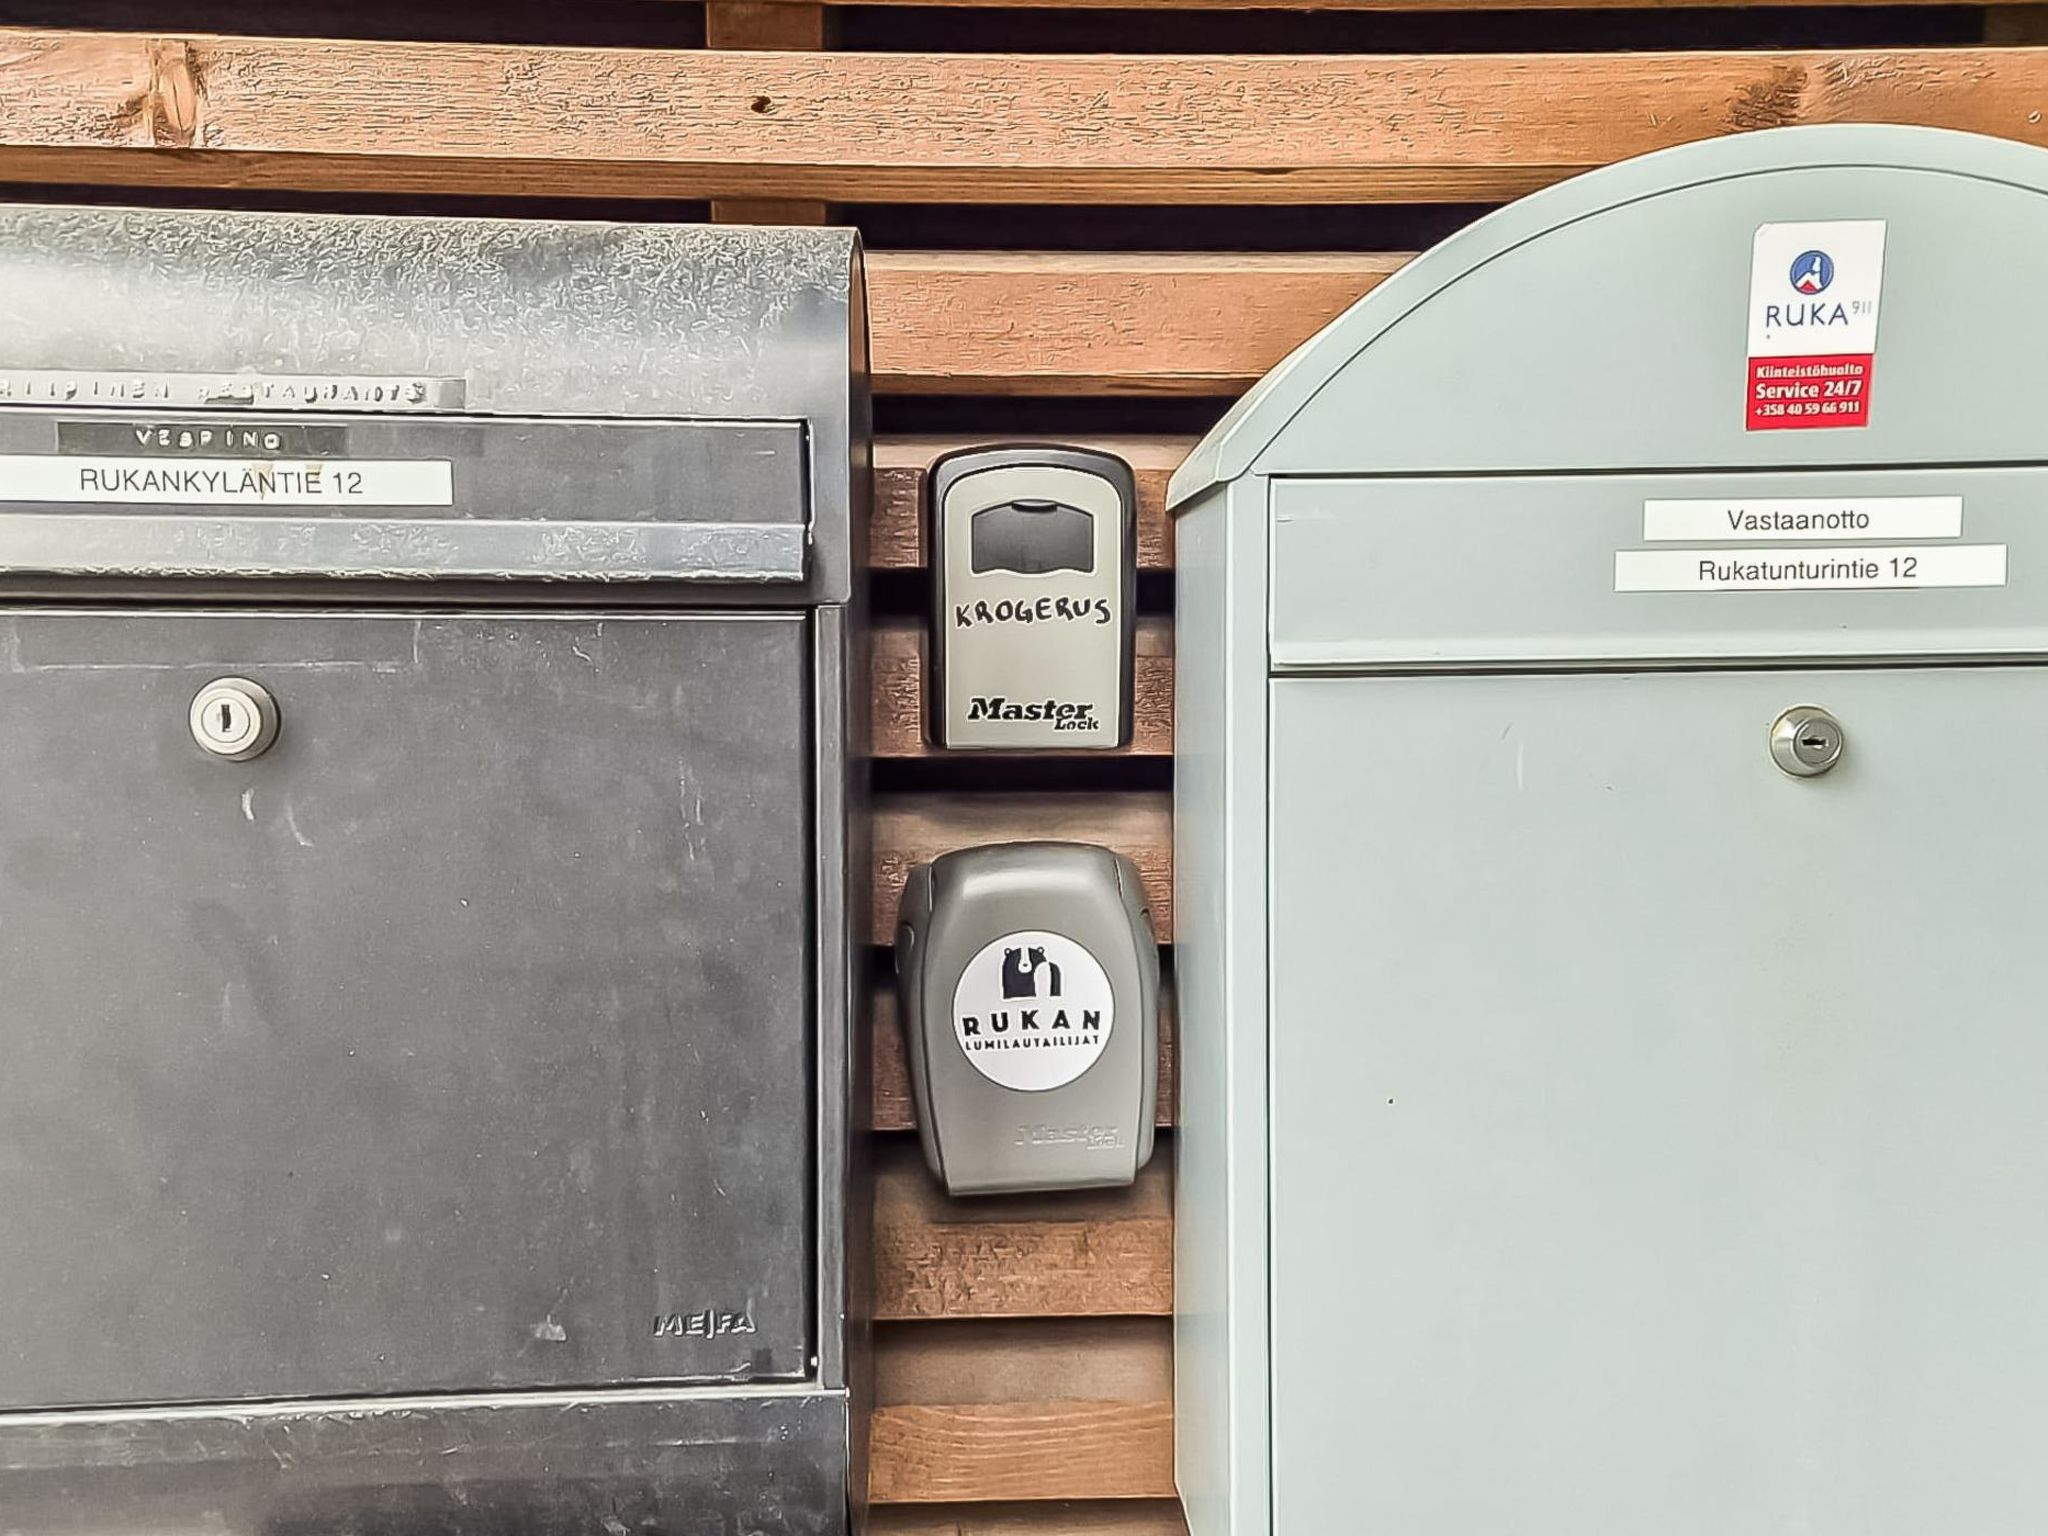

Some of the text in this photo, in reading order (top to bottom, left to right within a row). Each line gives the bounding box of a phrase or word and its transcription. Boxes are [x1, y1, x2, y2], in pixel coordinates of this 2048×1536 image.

[1765, 301, 1872, 327] RUKA 911
[1756, 364, 1864, 379] Kiinteistöhuolto
[1756, 380, 1862, 399] Service 24/7
[1755, 401, 1860, 416] +358 40 59 66 911
[80, 468, 364, 494] RUKANKYLÄNTIE 12
[1727, 509, 1870, 531] Vastaanotto
[1698, 557, 1918, 582] Rukatunturintie 12
[955, 596, 1111, 628] KROGERUS
[967, 698, 1094, 721] Master
[1054, 717, 1099, 731] Lock
[962, 1009, 1101, 1037] RUKAN
[965, 1034, 1100, 1051] LUMILAUTAILIJAT
